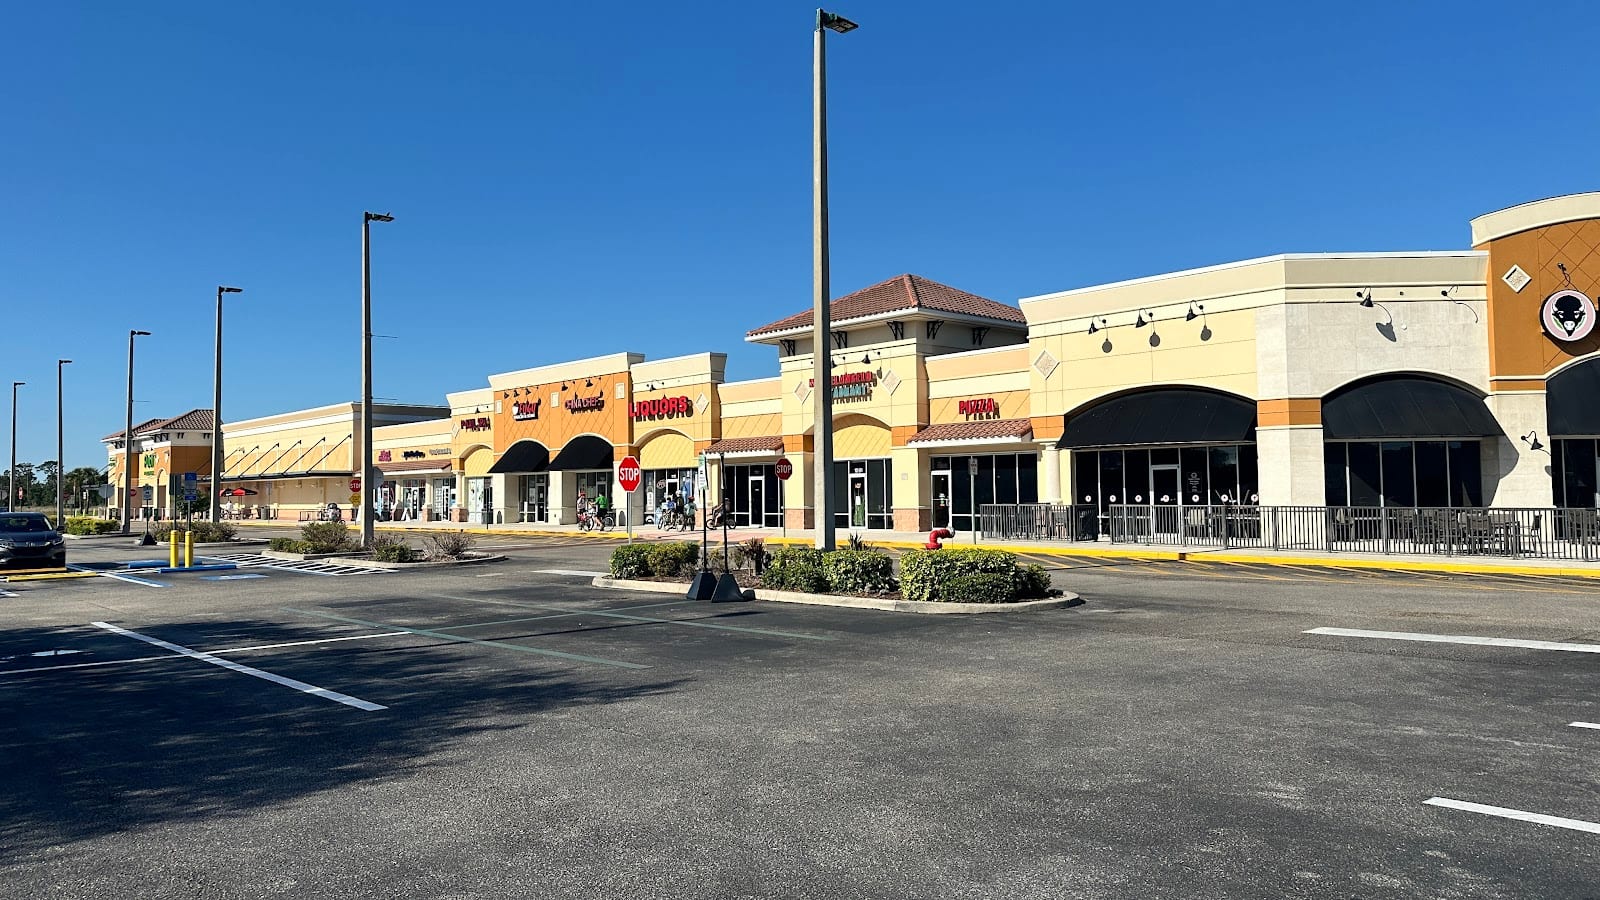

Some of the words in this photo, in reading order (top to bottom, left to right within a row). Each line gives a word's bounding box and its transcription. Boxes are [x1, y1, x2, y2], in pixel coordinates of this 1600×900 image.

[582, 396, 599, 408] CHEF
[629, 396, 689, 417] LIQUORS
[959, 398, 995, 414] PIZZA
[620, 467, 639, 481] STOP
[776, 465, 791, 474] STOP
